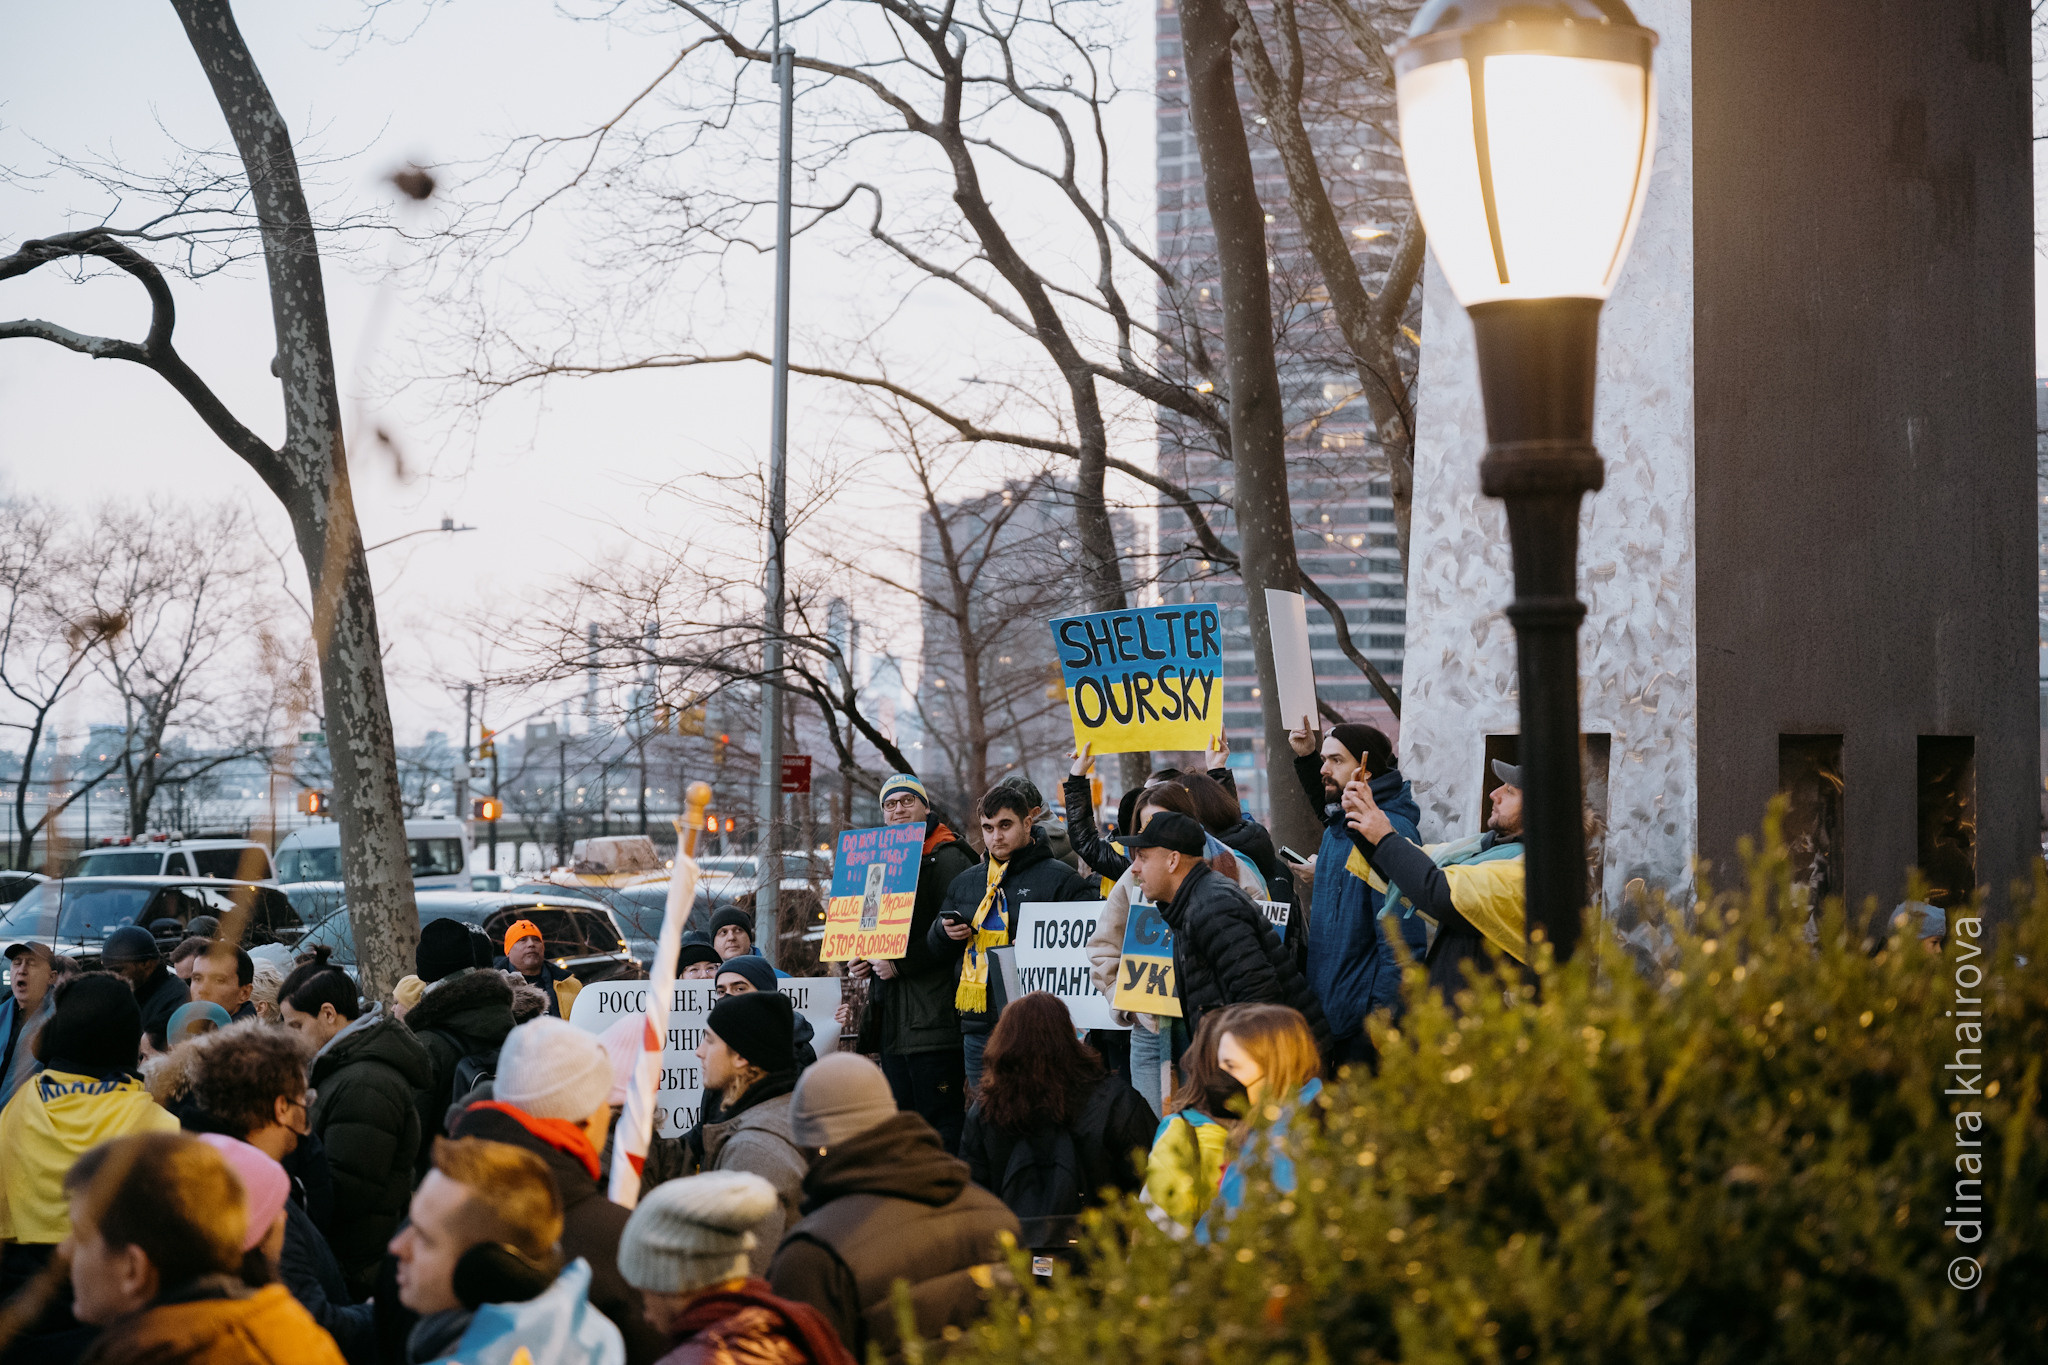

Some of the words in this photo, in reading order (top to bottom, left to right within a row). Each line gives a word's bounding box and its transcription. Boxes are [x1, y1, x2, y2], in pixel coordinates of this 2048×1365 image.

[1060, 610, 1220, 669] SHELTER
[843, 834, 857, 852] DO
[859, 831, 878, 848] NOT
[878, 828, 896, 848] LET
[855, 933, 907, 957] BLOODSHED
[1033, 919, 1097, 949] ПОЗОР
[1018, 966, 1104, 996] ККУПАНТ
[599, 988, 702, 1015] РОССНЕ,
